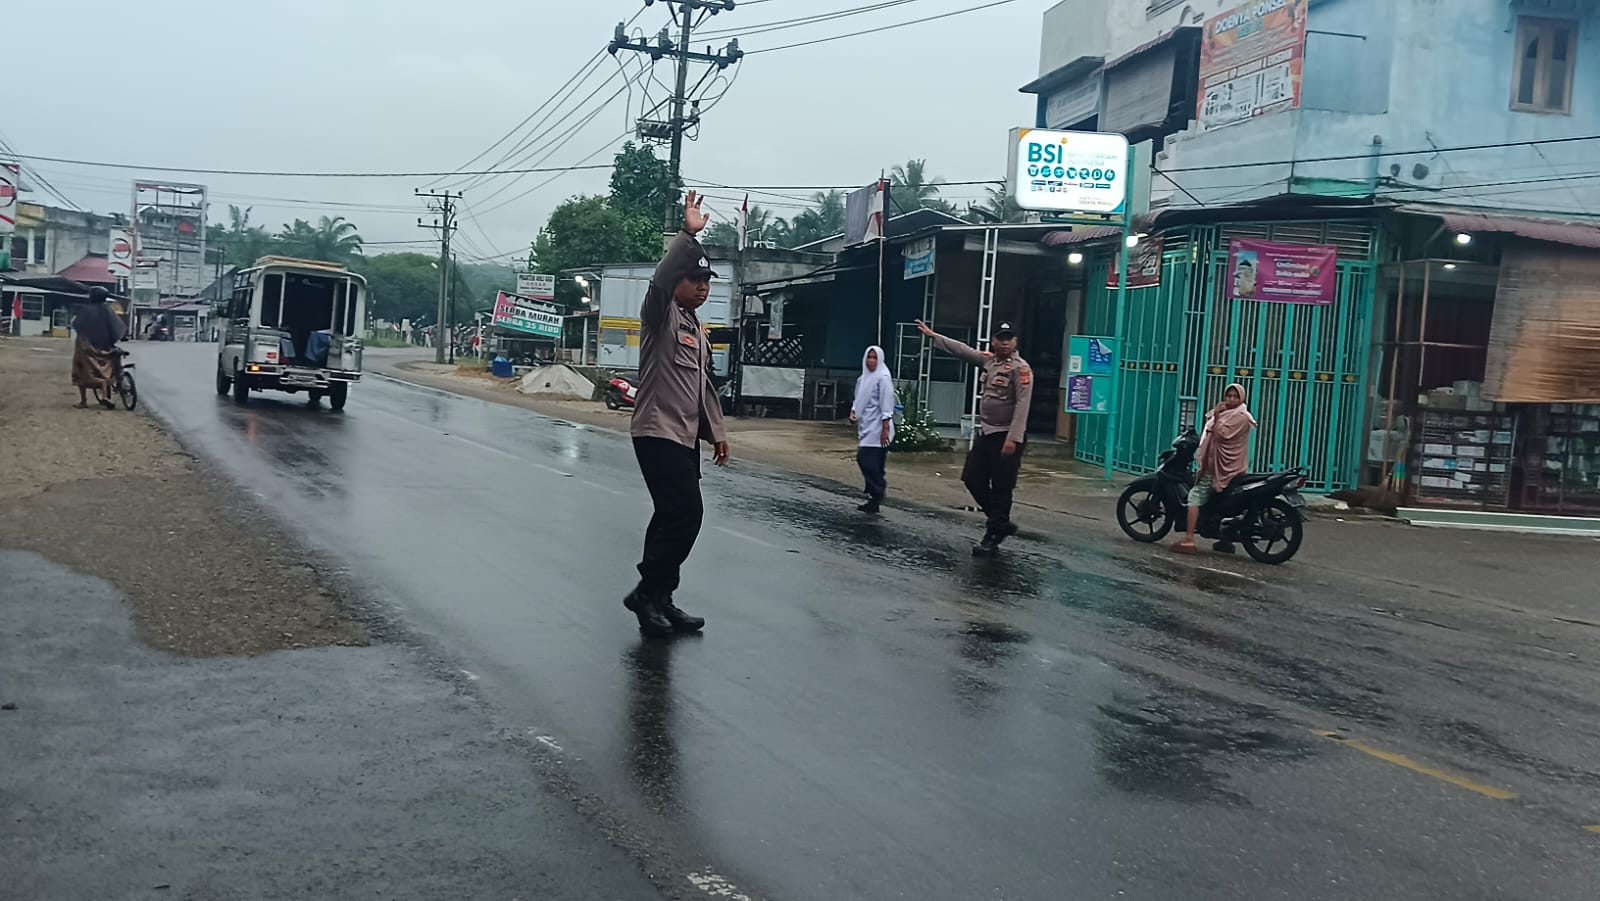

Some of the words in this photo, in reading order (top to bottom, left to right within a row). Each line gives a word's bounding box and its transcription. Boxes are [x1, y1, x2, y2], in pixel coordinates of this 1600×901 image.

[1028, 139, 1066, 164] BSI
[500, 304, 527, 318] SERBA
[528, 311, 560, 324] MURAH
[496, 315, 523, 327] SERBA
[525, 321, 537, 330] 35
[538, 323, 560, 334] RIBU
